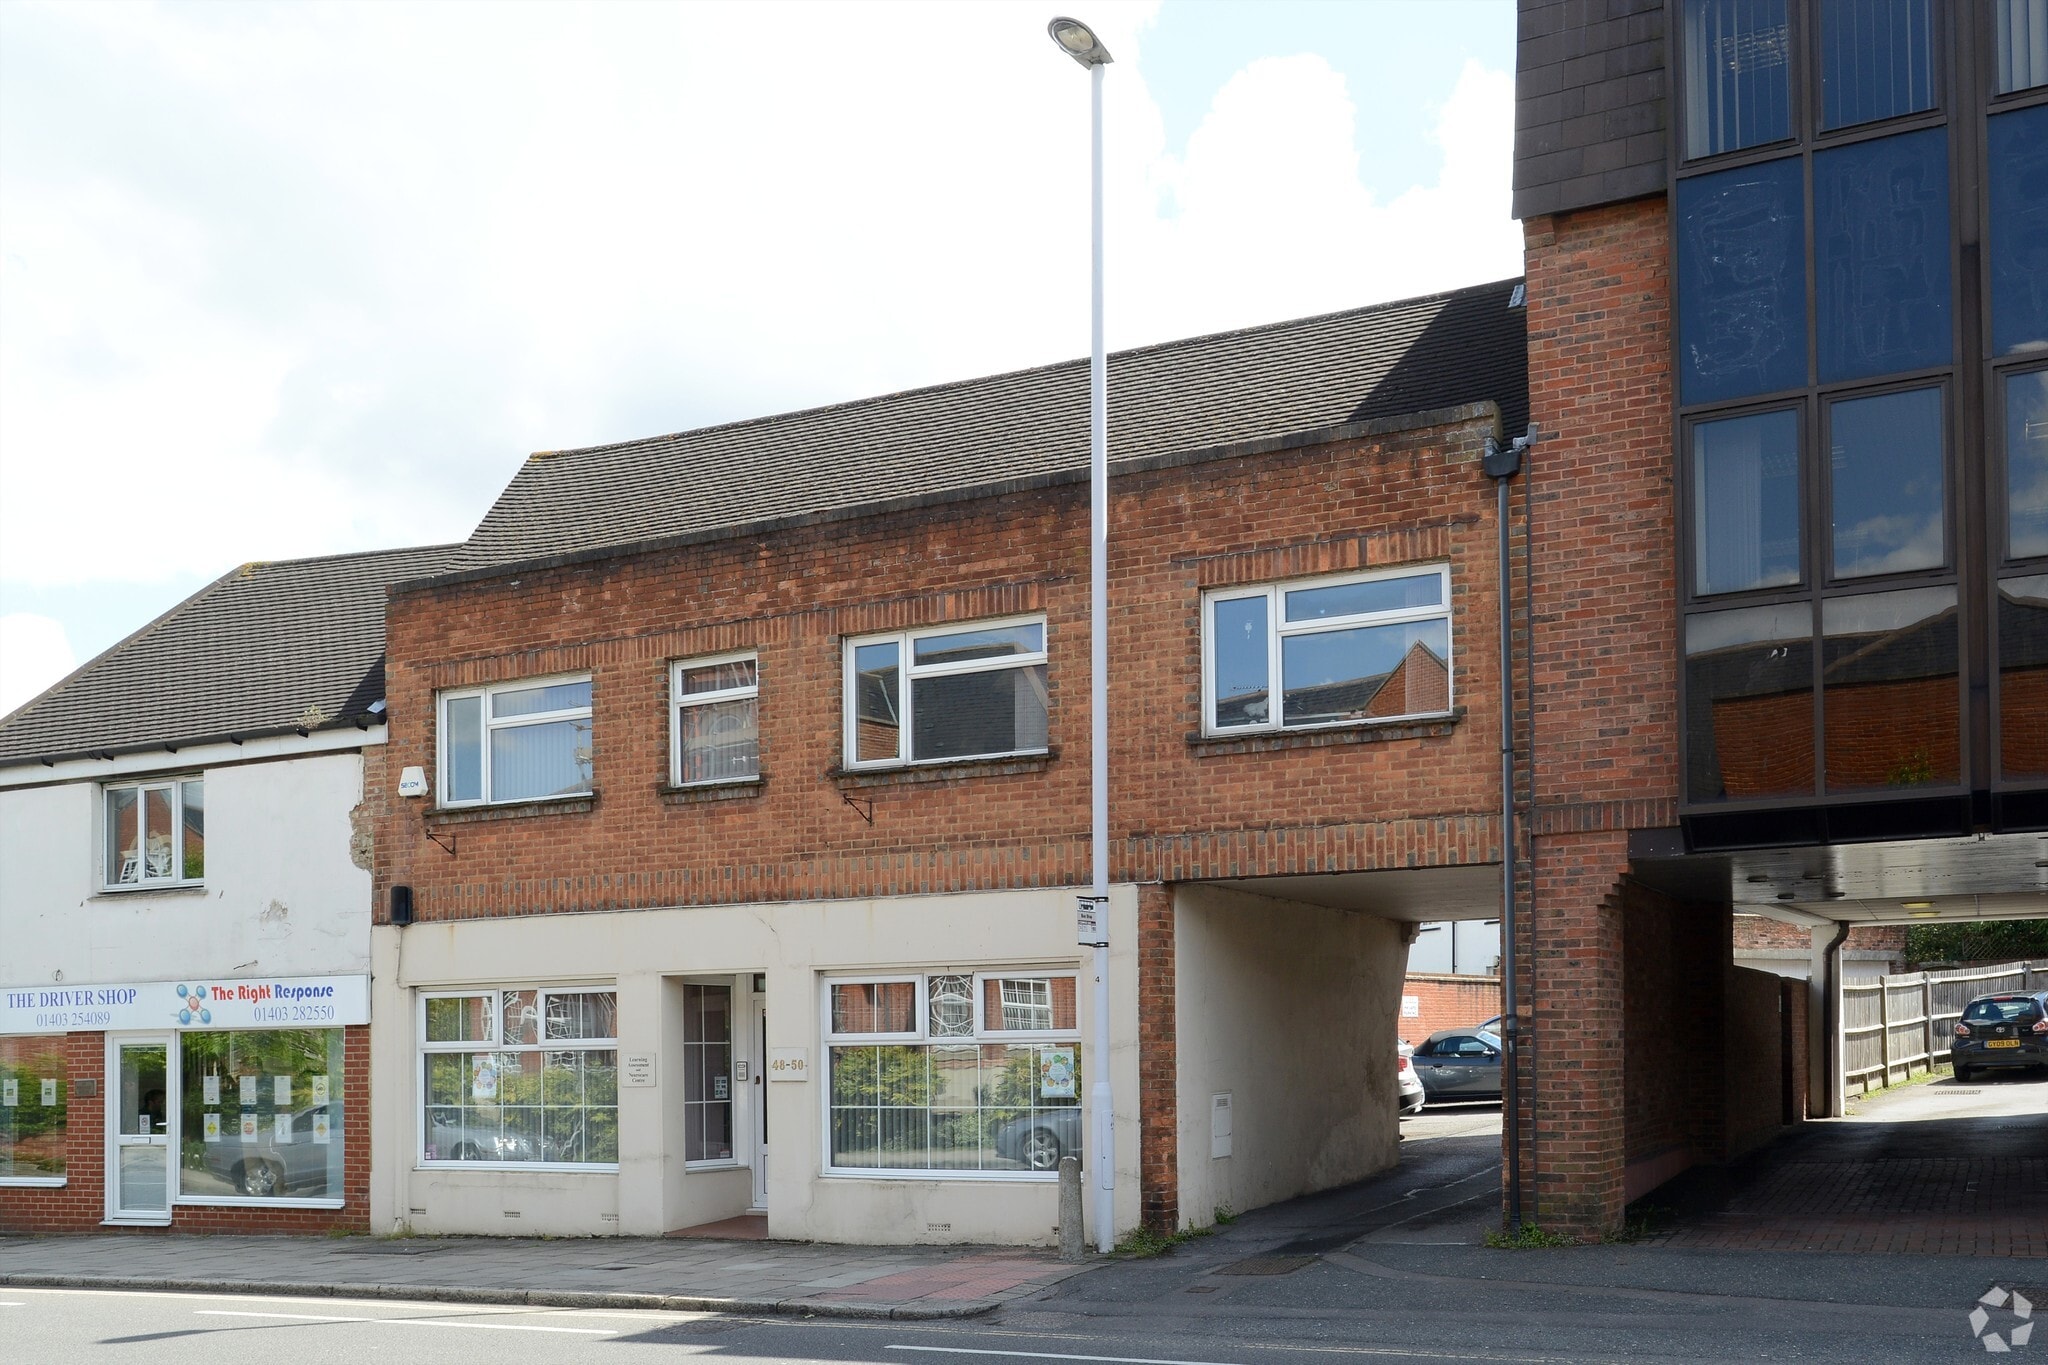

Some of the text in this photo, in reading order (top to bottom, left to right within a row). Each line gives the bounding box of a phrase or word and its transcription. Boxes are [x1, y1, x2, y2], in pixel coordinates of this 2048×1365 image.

[7, 988, 136, 1008] THE DRIVER SHOP
[211, 984, 334, 1004] The Right Response
[36, 1011, 110, 1026] 01403 254089
[254, 1005, 335, 1021] 01403 282550
[772, 1059, 803, 1070] 48-50
